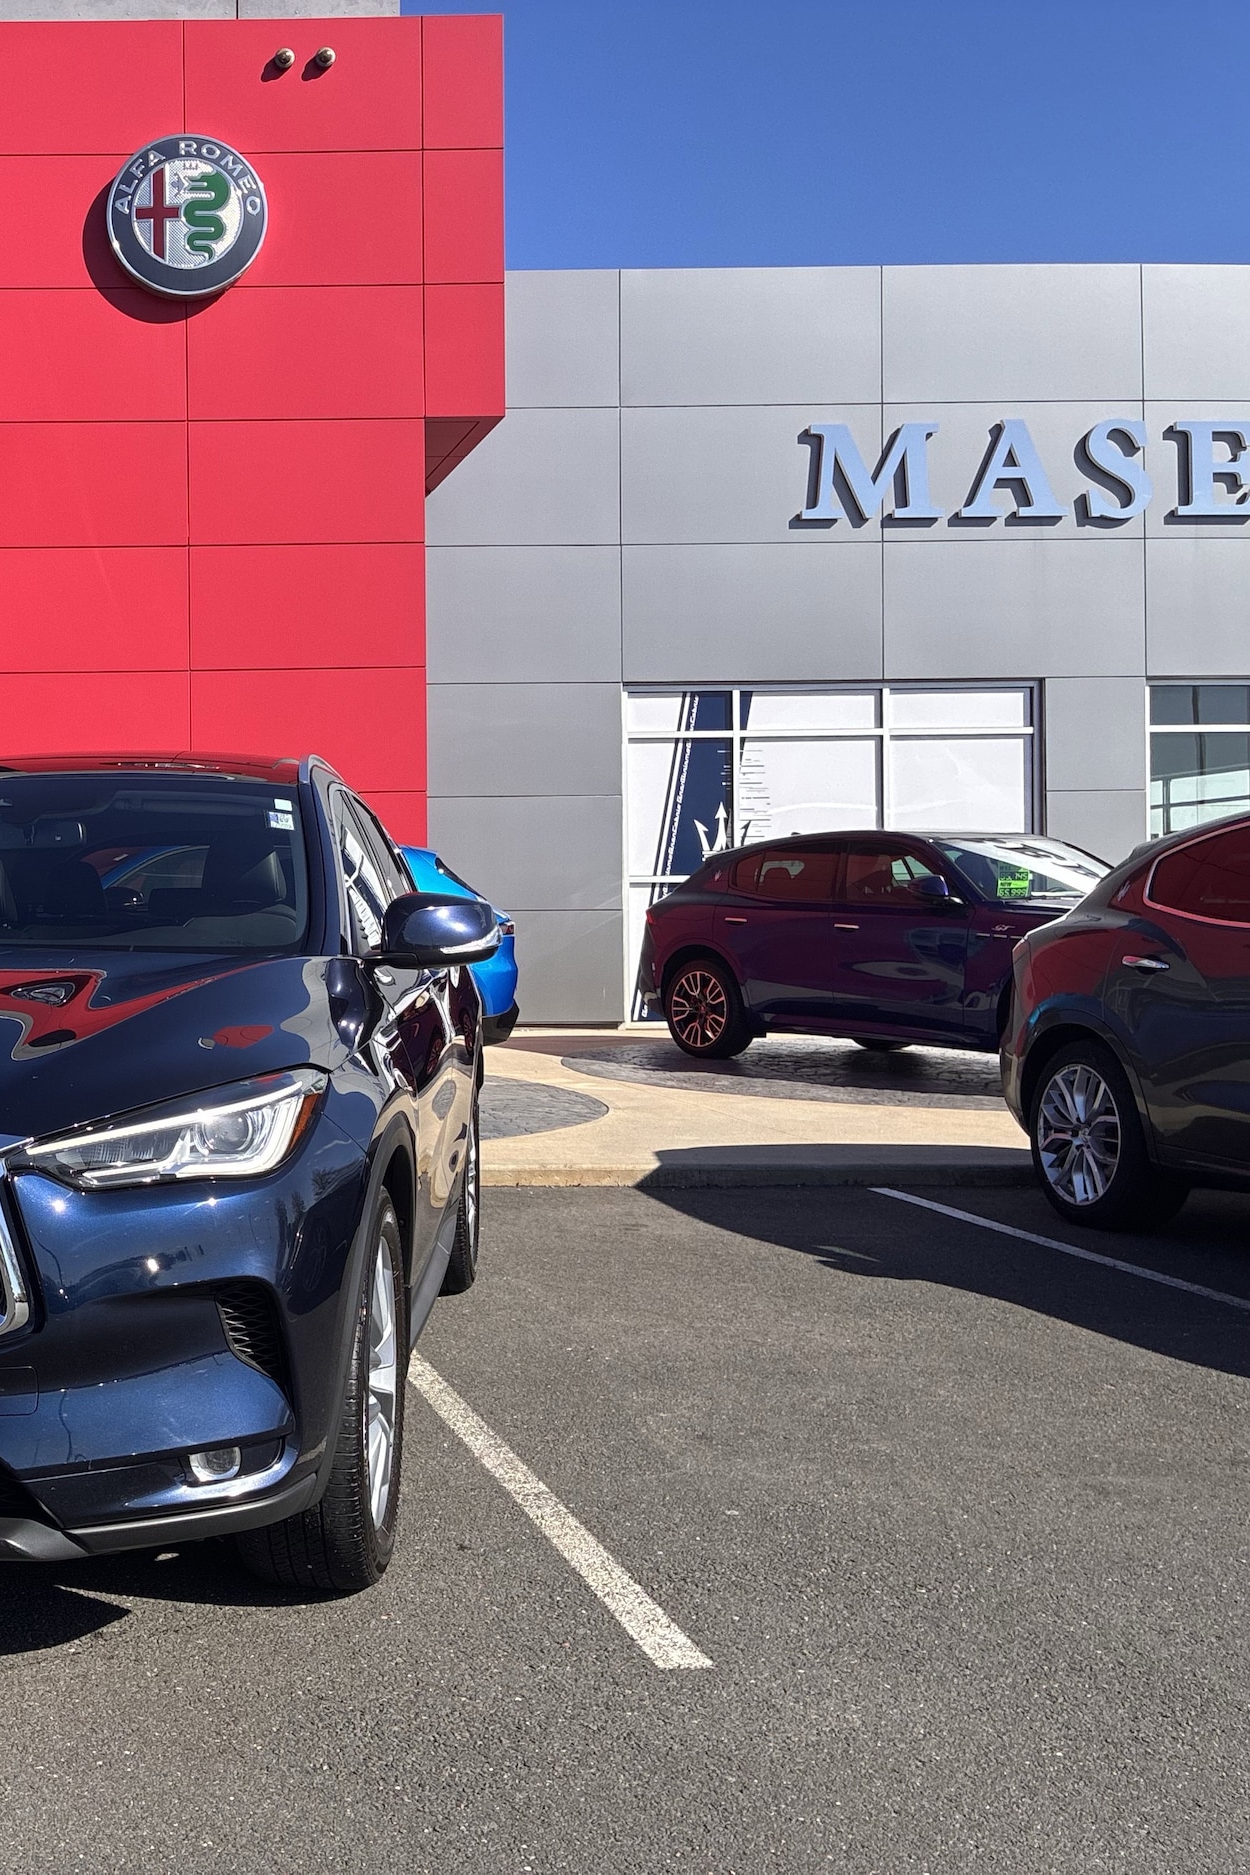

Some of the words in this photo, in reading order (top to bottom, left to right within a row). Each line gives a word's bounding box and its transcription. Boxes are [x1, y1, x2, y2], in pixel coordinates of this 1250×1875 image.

[115, 150, 167, 215] ALFA
[178, 140, 261, 216] ROMEO
[800, 417, 1250, 520] MASE
